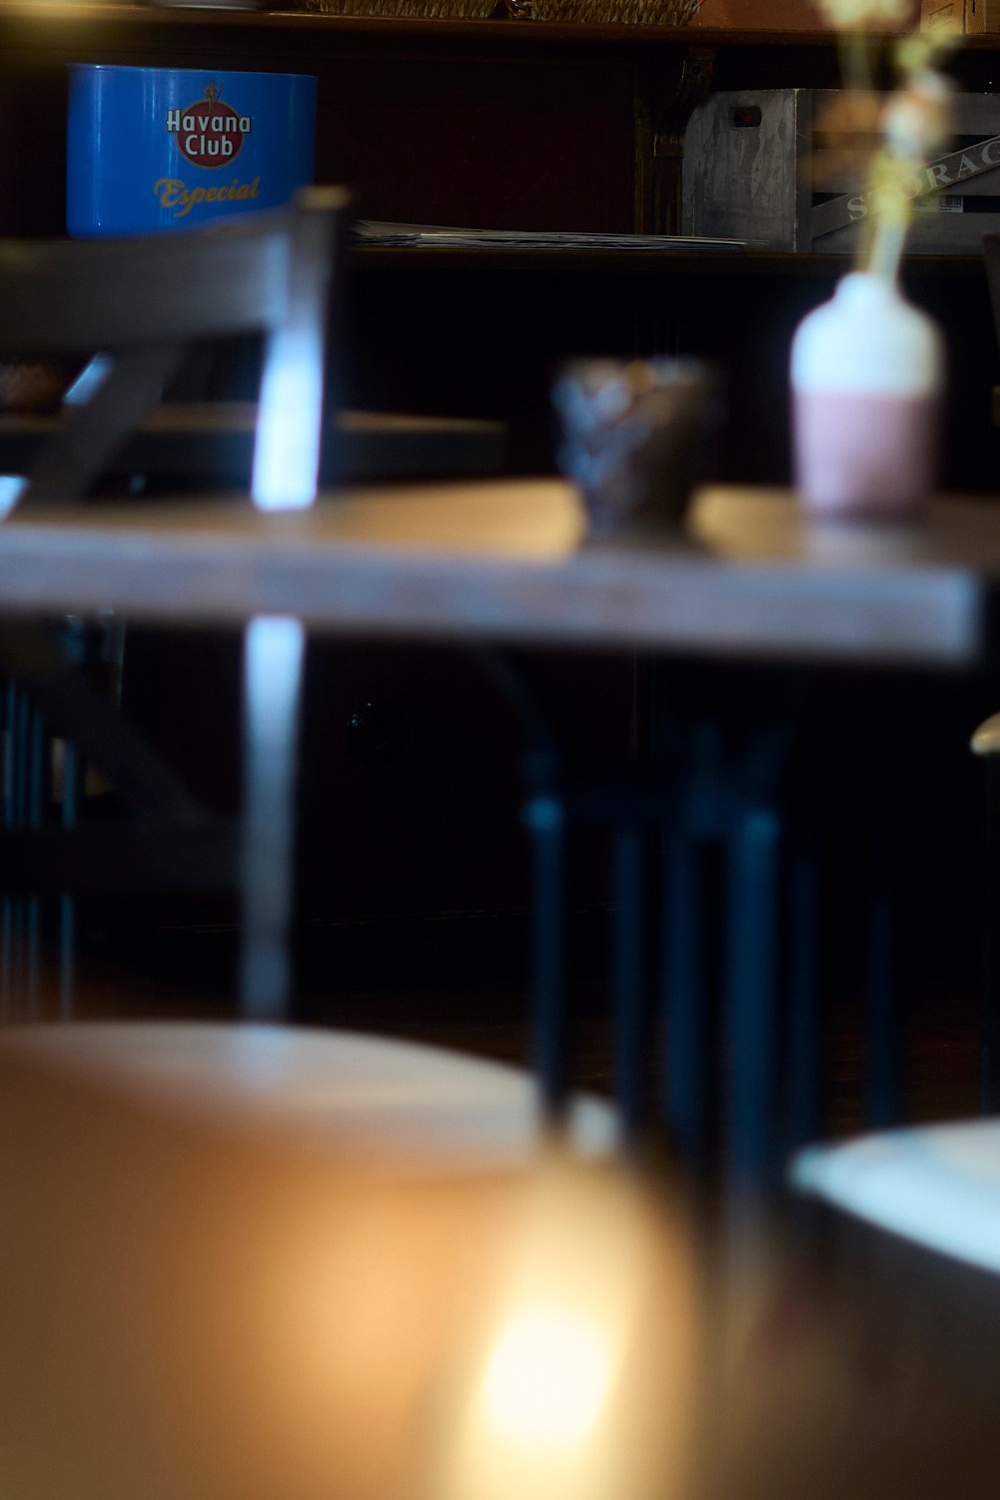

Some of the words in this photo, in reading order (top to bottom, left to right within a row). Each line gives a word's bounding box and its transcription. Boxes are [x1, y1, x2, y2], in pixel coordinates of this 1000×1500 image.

[166, 109, 251, 133] Havana
[185, 134, 233, 156] Club
[154, 175, 261, 218] Especial
